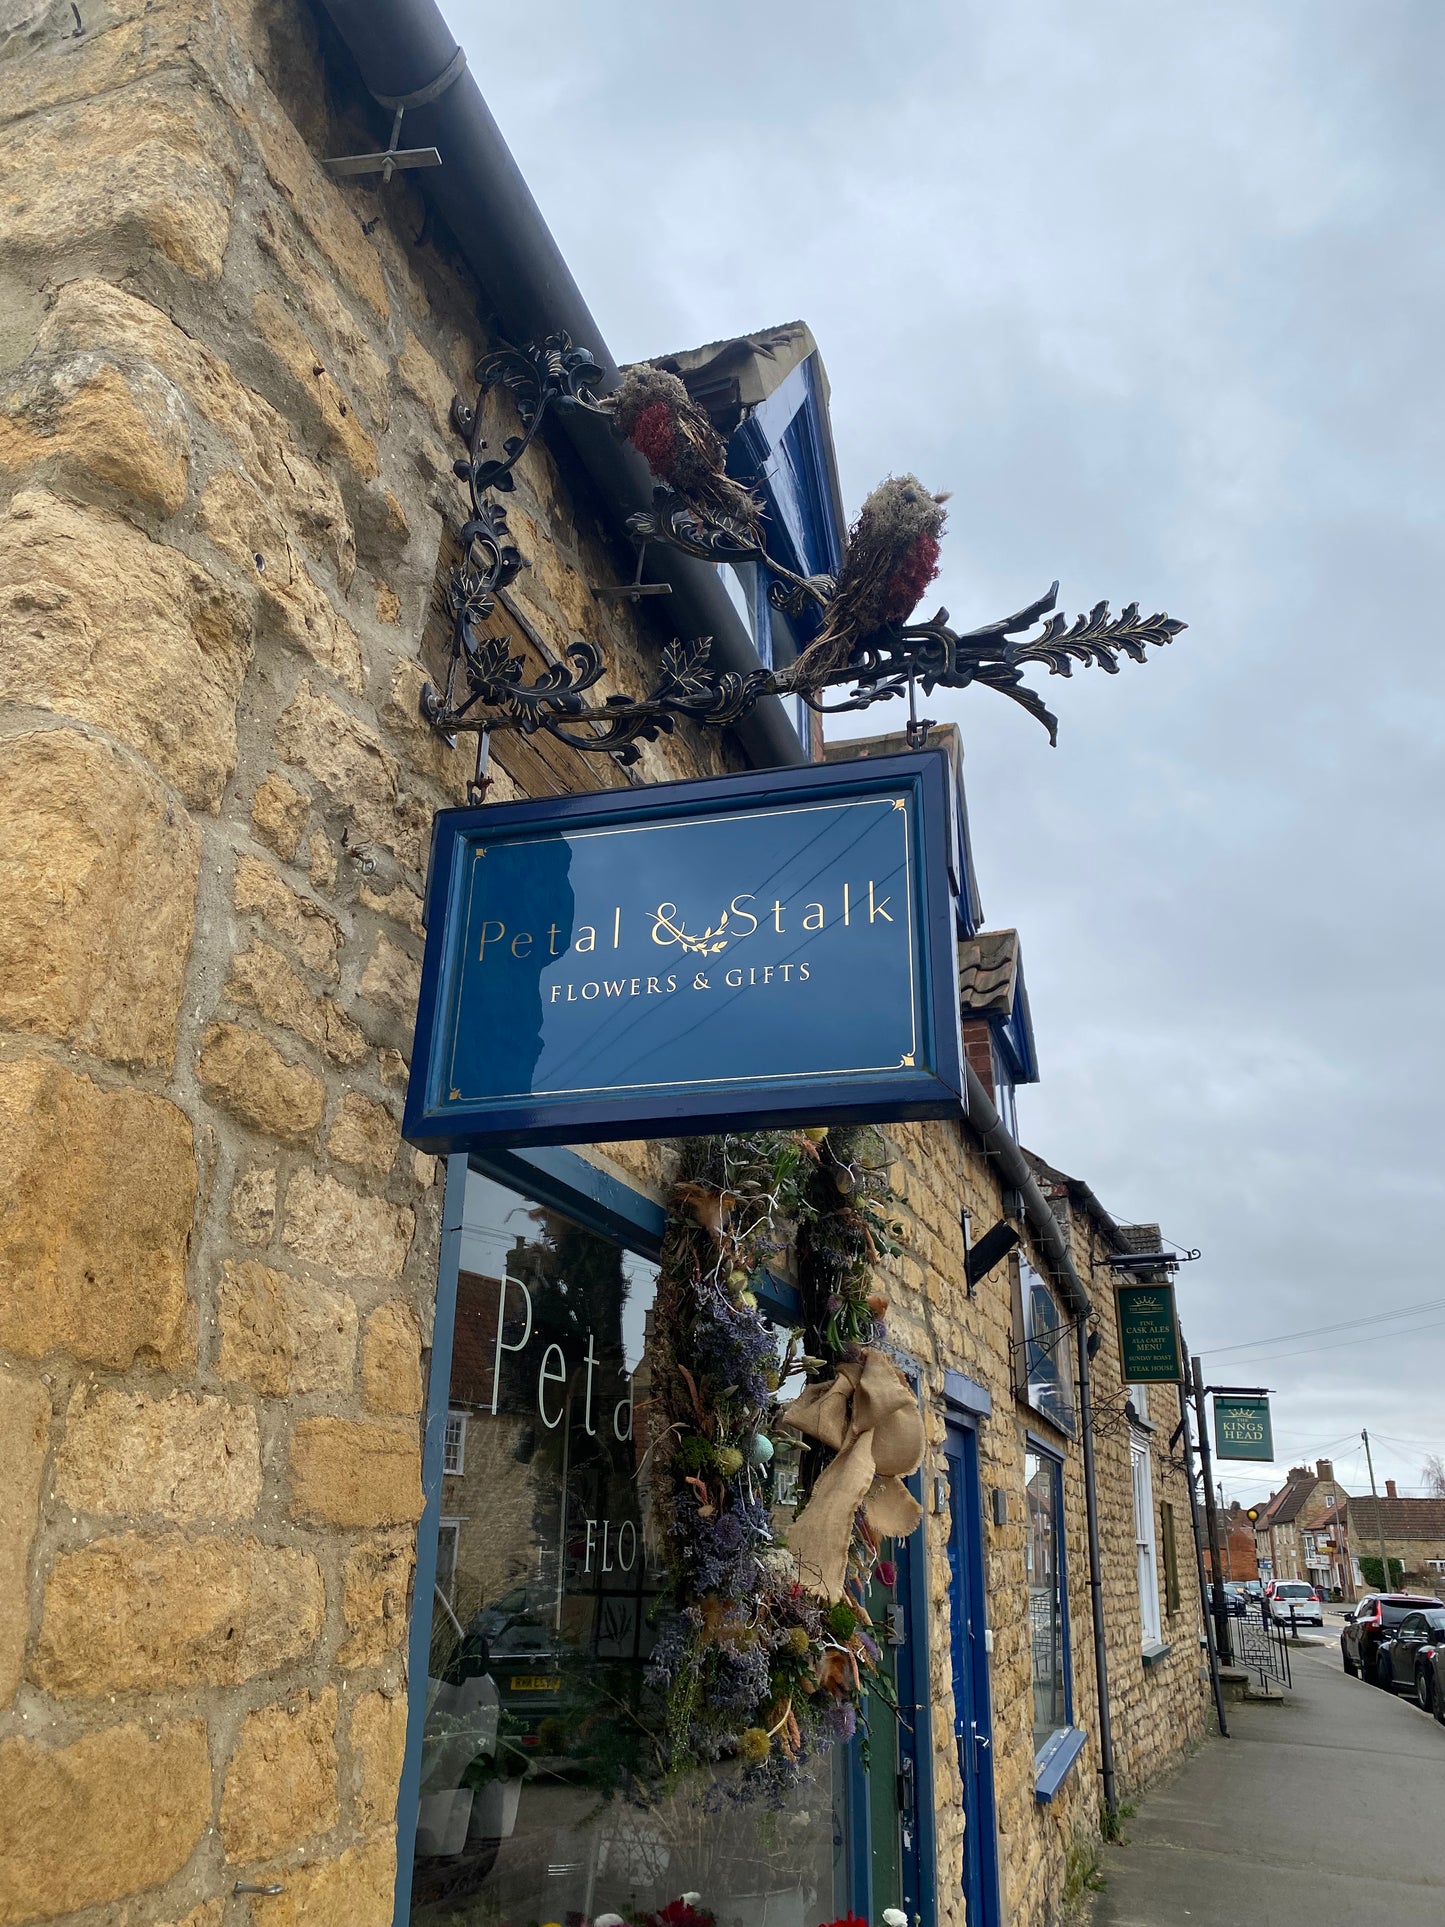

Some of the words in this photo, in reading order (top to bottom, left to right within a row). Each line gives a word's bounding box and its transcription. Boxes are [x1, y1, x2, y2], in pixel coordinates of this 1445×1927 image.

[479, 906, 621, 962] Petal
[730, 880, 895, 937] Stalk
[550, 974, 678, 1003] FLOWERS
[692, 972, 712, 991] &
[726, 962, 811, 987] GIFTS
[491, 1273, 635, 1442] Peta
[1136, 1343, 1162, 1351] MENU
[1223, 1422, 1264, 1431] KINGS
[1225, 1430, 1263, 1440] HEAD
